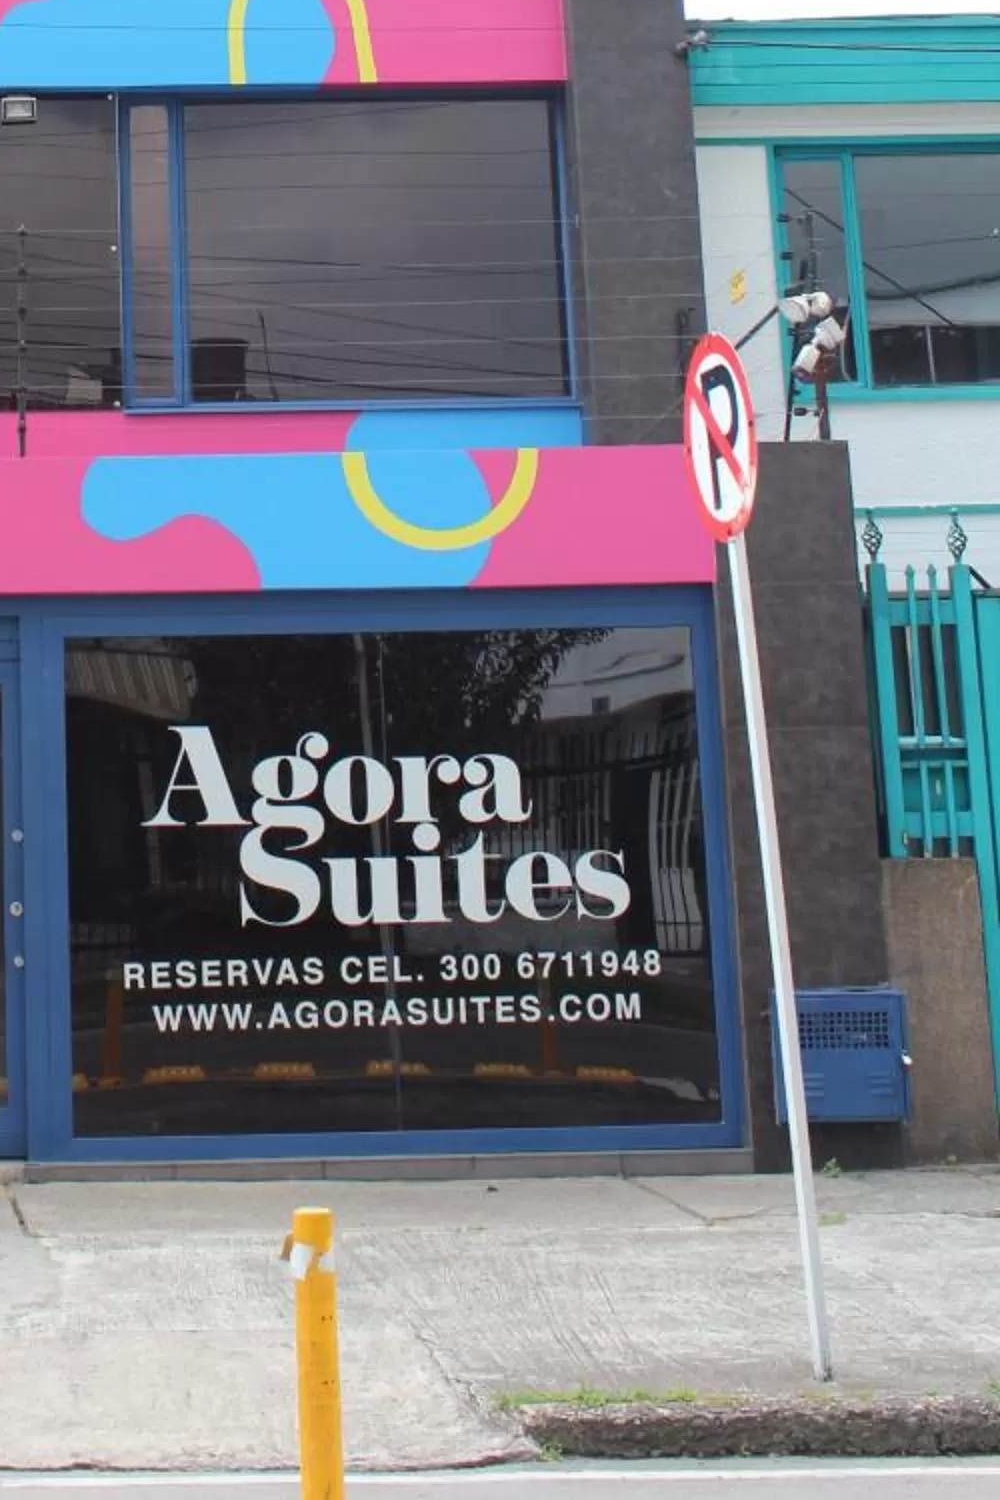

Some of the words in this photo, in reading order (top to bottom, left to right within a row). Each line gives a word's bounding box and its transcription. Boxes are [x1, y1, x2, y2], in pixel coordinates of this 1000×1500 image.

[140, 725, 533, 851] Agora
[239, 823, 632, 927] Suites
[122, 957, 324, 990] RESERVAS
[340, 955, 424, 984] CEL.
[440, 954, 502, 981] 300
[516, 949, 662, 979] 6711948
[152, 993, 642, 1032] WWW.AGORASUITES.COM
